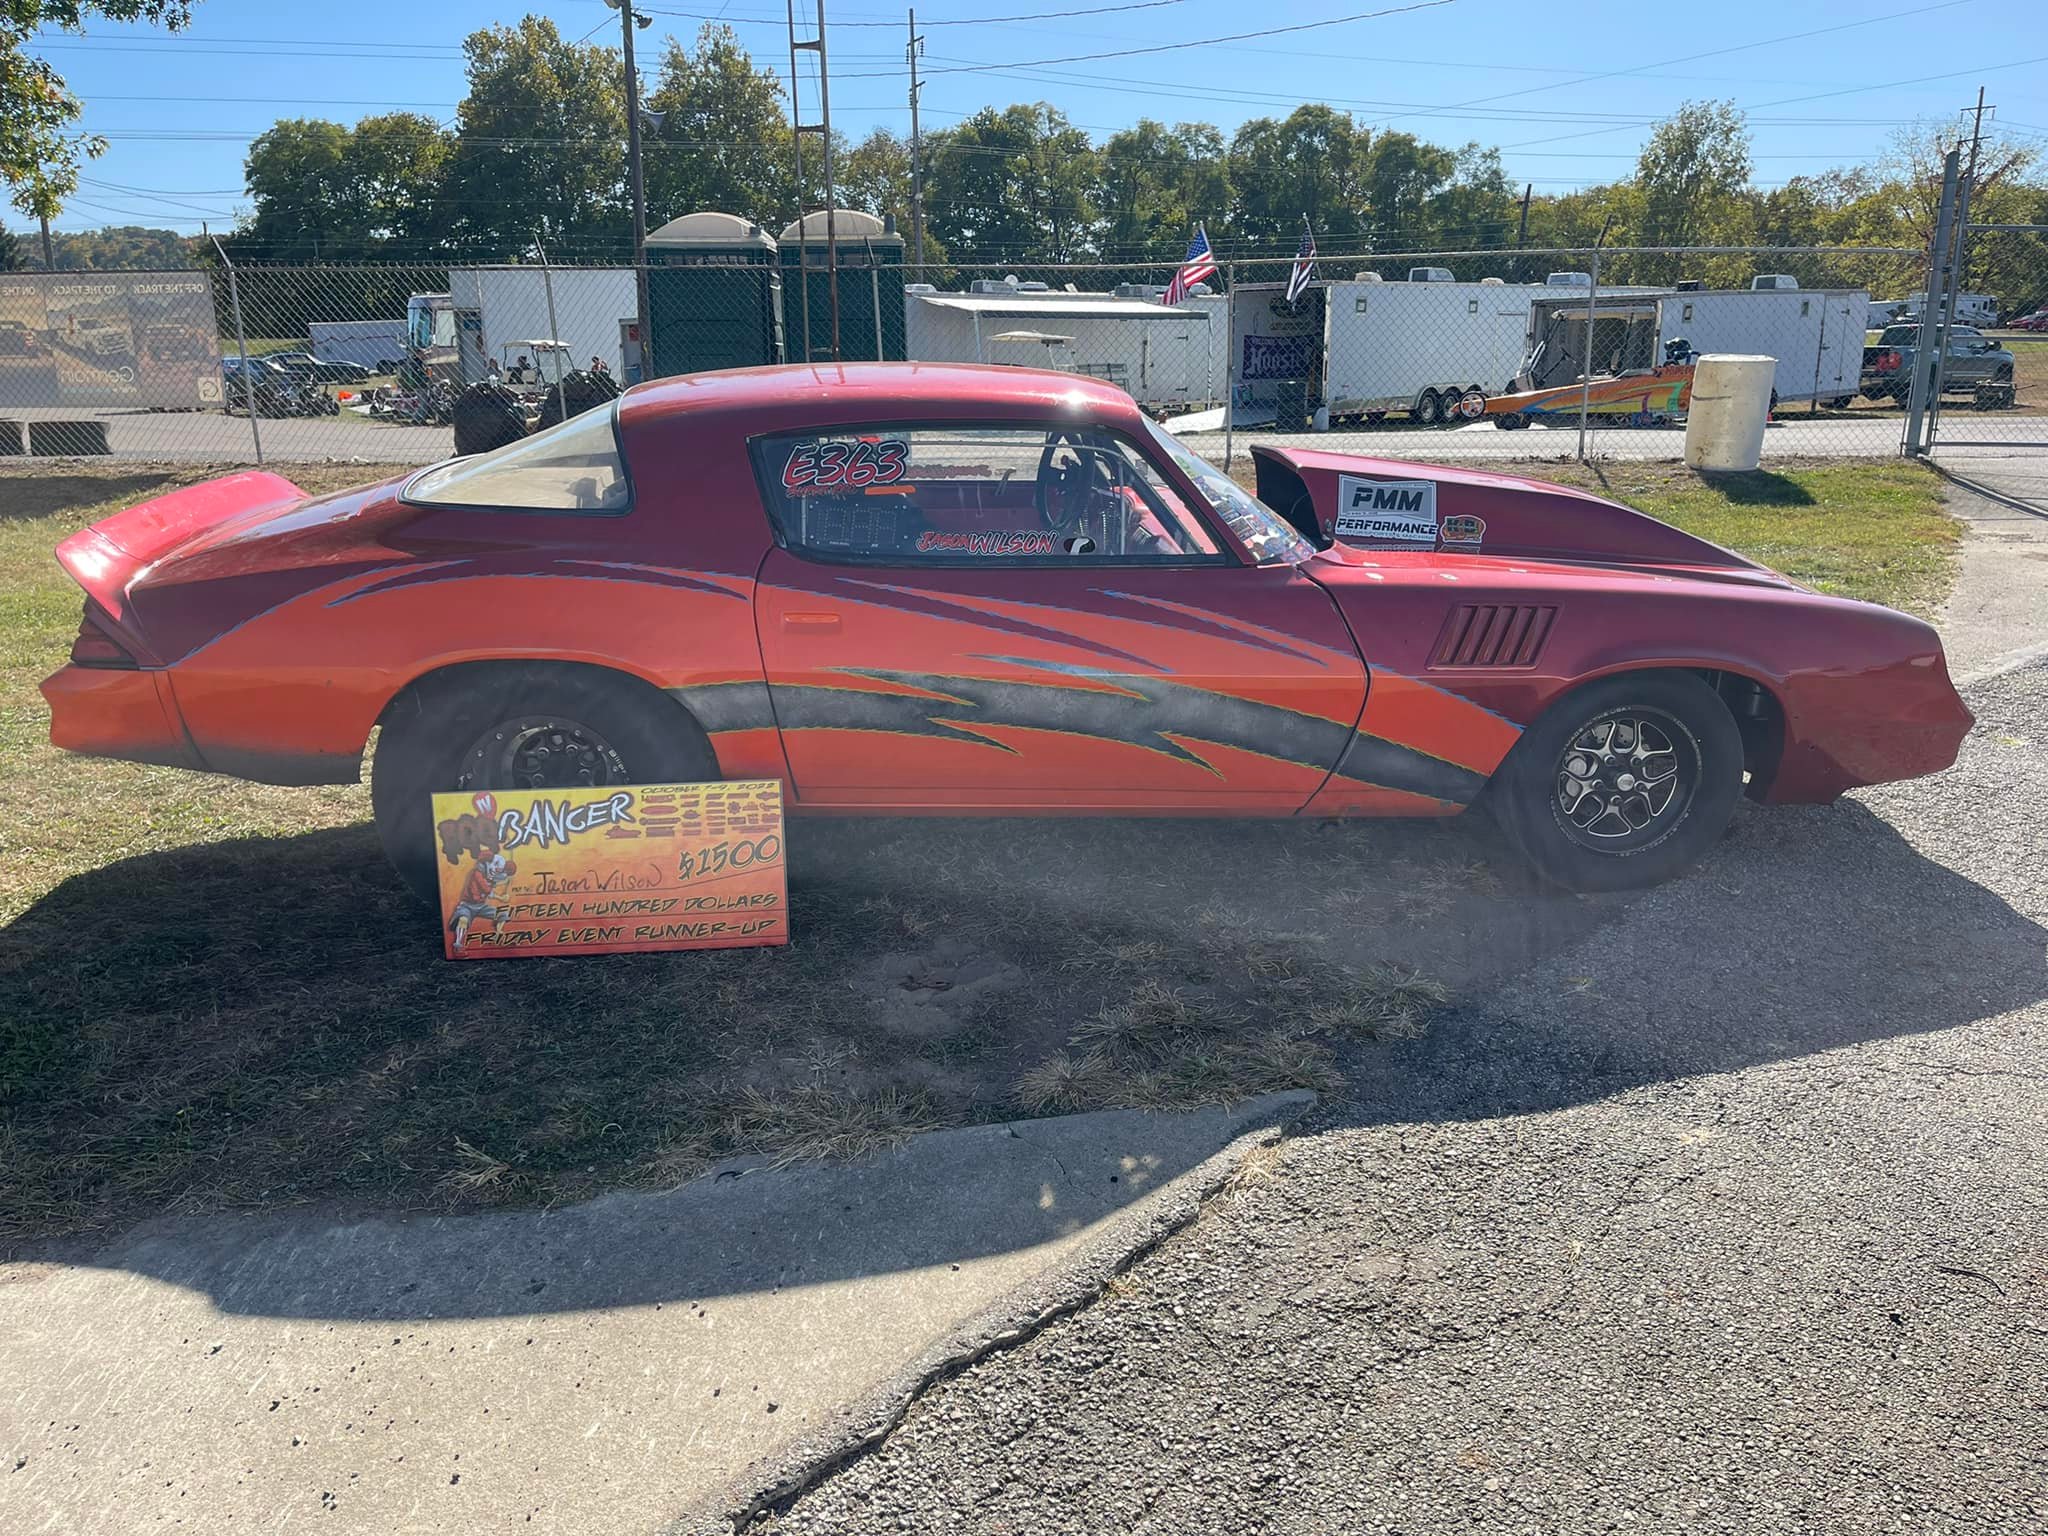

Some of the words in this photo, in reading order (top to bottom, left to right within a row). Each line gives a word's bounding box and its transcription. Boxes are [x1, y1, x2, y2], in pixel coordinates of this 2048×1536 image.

[782, 441, 907, 487] E363
[1352, 486, 1424, 511] PMM
[1337, 518, 1437, 535] PERFORMANCE
[917, 531, 970, 551] JASON
[969, 530, 1057, 555] WILSON
[640, 785, 700, 794] OCTOBER
[737, 782, 776, 790] 2022
[475, 794, 492, 814] IV
[678, 835, 781, 881] $1500
[533, 871, 591, 895] Jason
[589, 863, 663, 891] Wilson
[495, 902, 574, 921] FIFTEEN
[583, 898, 679, 915] HUNDRED
[683, 892, 779, 911] DOLLARS
[464, 928, 550, 947] FRIDAY
[557, 926, 625, 944] EVENT
[634, 919, 777, 940] RUNNER-UP
